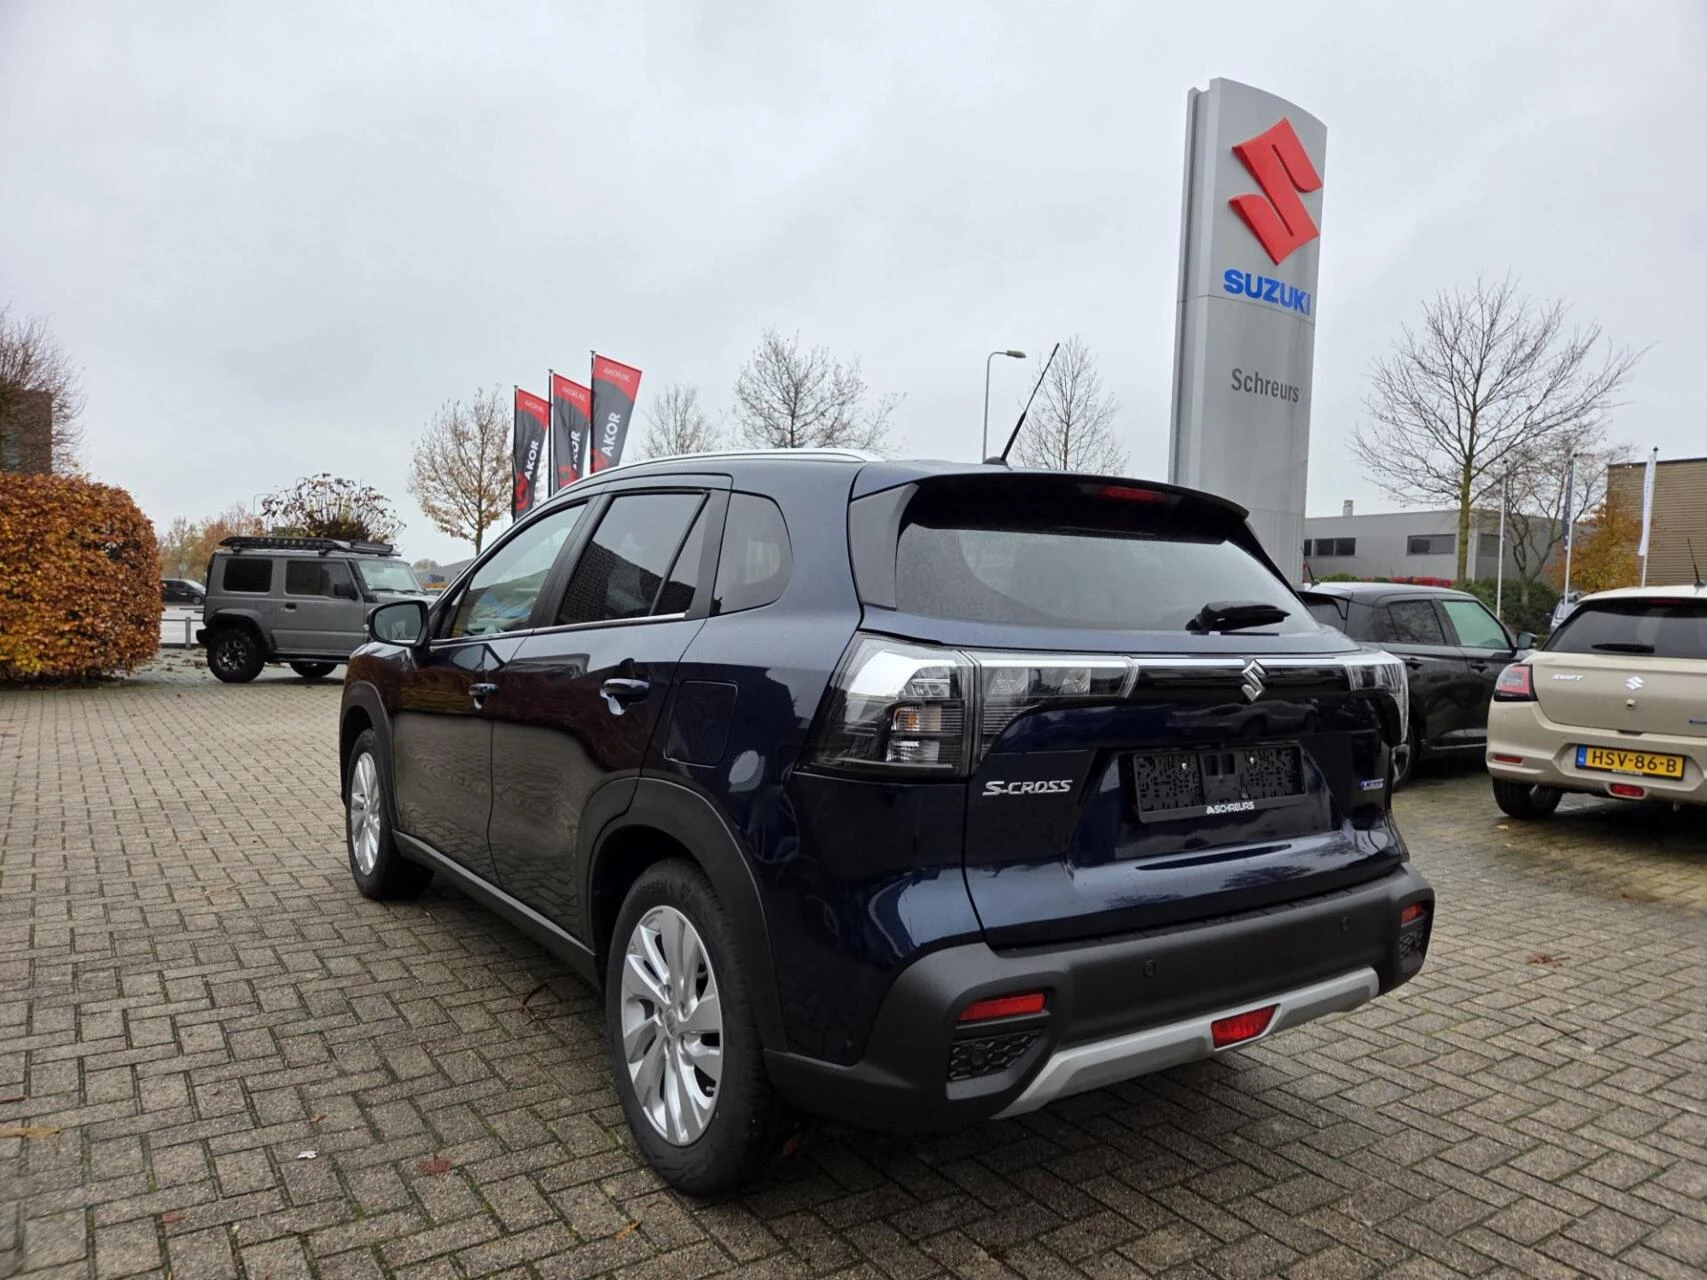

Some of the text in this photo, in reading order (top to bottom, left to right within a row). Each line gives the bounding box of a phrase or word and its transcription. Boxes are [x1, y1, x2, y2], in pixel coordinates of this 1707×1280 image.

[1223, 269, 1311, 316] SUZUKI
[1231, 368, 1299, 403] Schreurs
[601, 412, 621, 457] AKOR
[524, 440, 539, 480] AKOR
[1591, 750, 1677, 773] HSV-86-B
[982, 779, 1073, 796] S-CROSS
[1214, 801, 1255, 814] SCHREURS
